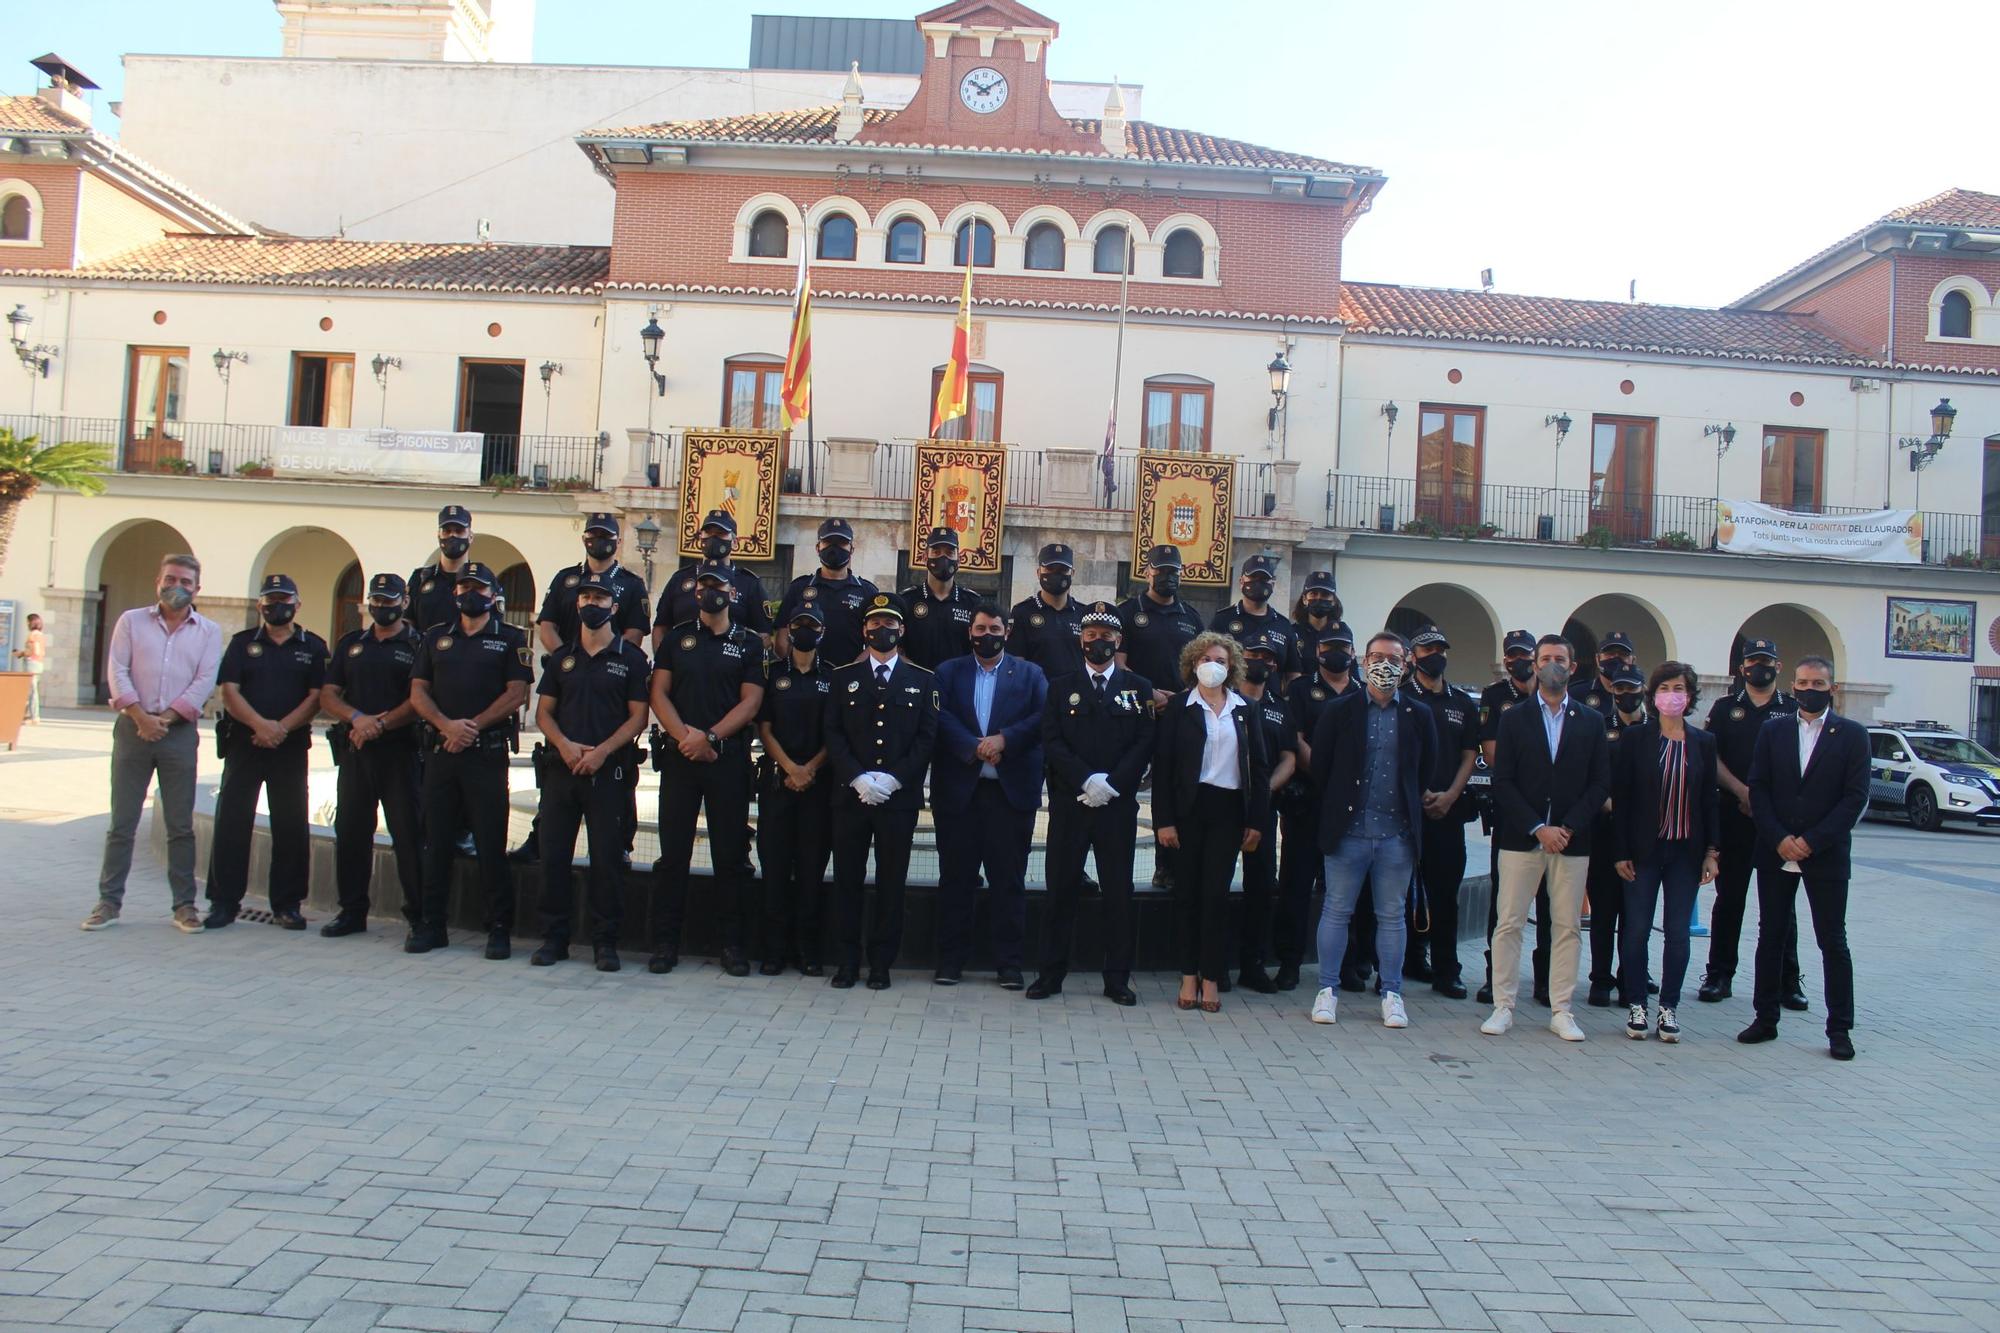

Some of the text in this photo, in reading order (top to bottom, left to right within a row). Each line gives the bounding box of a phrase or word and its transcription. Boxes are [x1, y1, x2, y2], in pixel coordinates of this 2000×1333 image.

[282, 431, 327, 445] NULES
[337, 433, 379, 447] EXIG
[380, 434, 449, 449] ESPIGONES
[280, 455, 374, 472] DE SU PLAYA
[1725, 515, 1778, 527] PLATAFORMA
[1779, 520, 1796, 529] PER
[1810, 523, 1847, 533] DIGNITAT
[1848, 524, 1863, 533] DEL
[1865, 525, 1913, 534] LLAURADOR
[1753, 531, 1769, 540] Tots
[1770, 532, 1789, 542] junts
[1791, 535, 1804, 544] per
[1814, 537, 1838, 545] nostra
[1840, 538, 1883, 547] citricultura
[952, 608, 972, 616] POLICA
